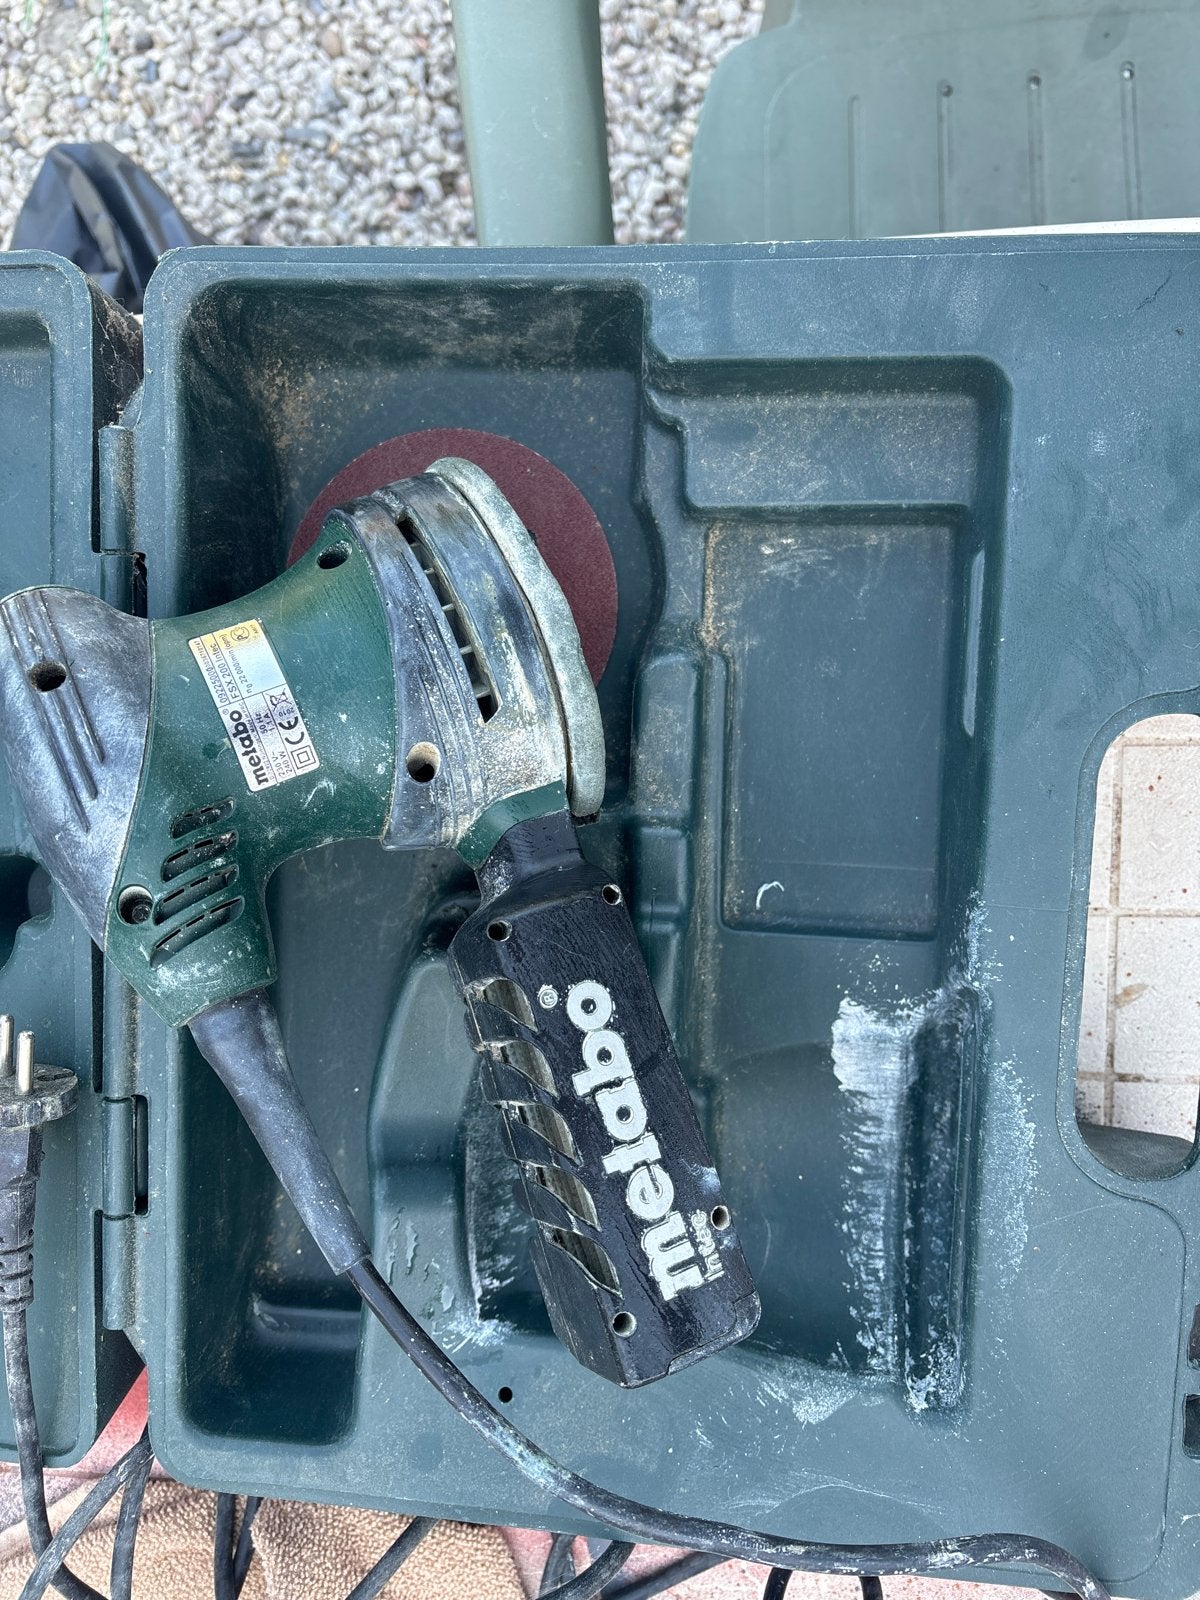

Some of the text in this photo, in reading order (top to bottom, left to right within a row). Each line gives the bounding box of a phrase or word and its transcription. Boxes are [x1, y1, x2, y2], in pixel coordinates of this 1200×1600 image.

[208, 642, 239, 699] FSX 200 Intec
[253, 711, 268, 734] 50 Hz
[261, 712, 270, 720] A
[230, 710, 269, 785] metabo
[273, 761, 285, 777] 230
[277, 749, 293, 774] 240 W
[566, 980, 702, 1301] metabo
